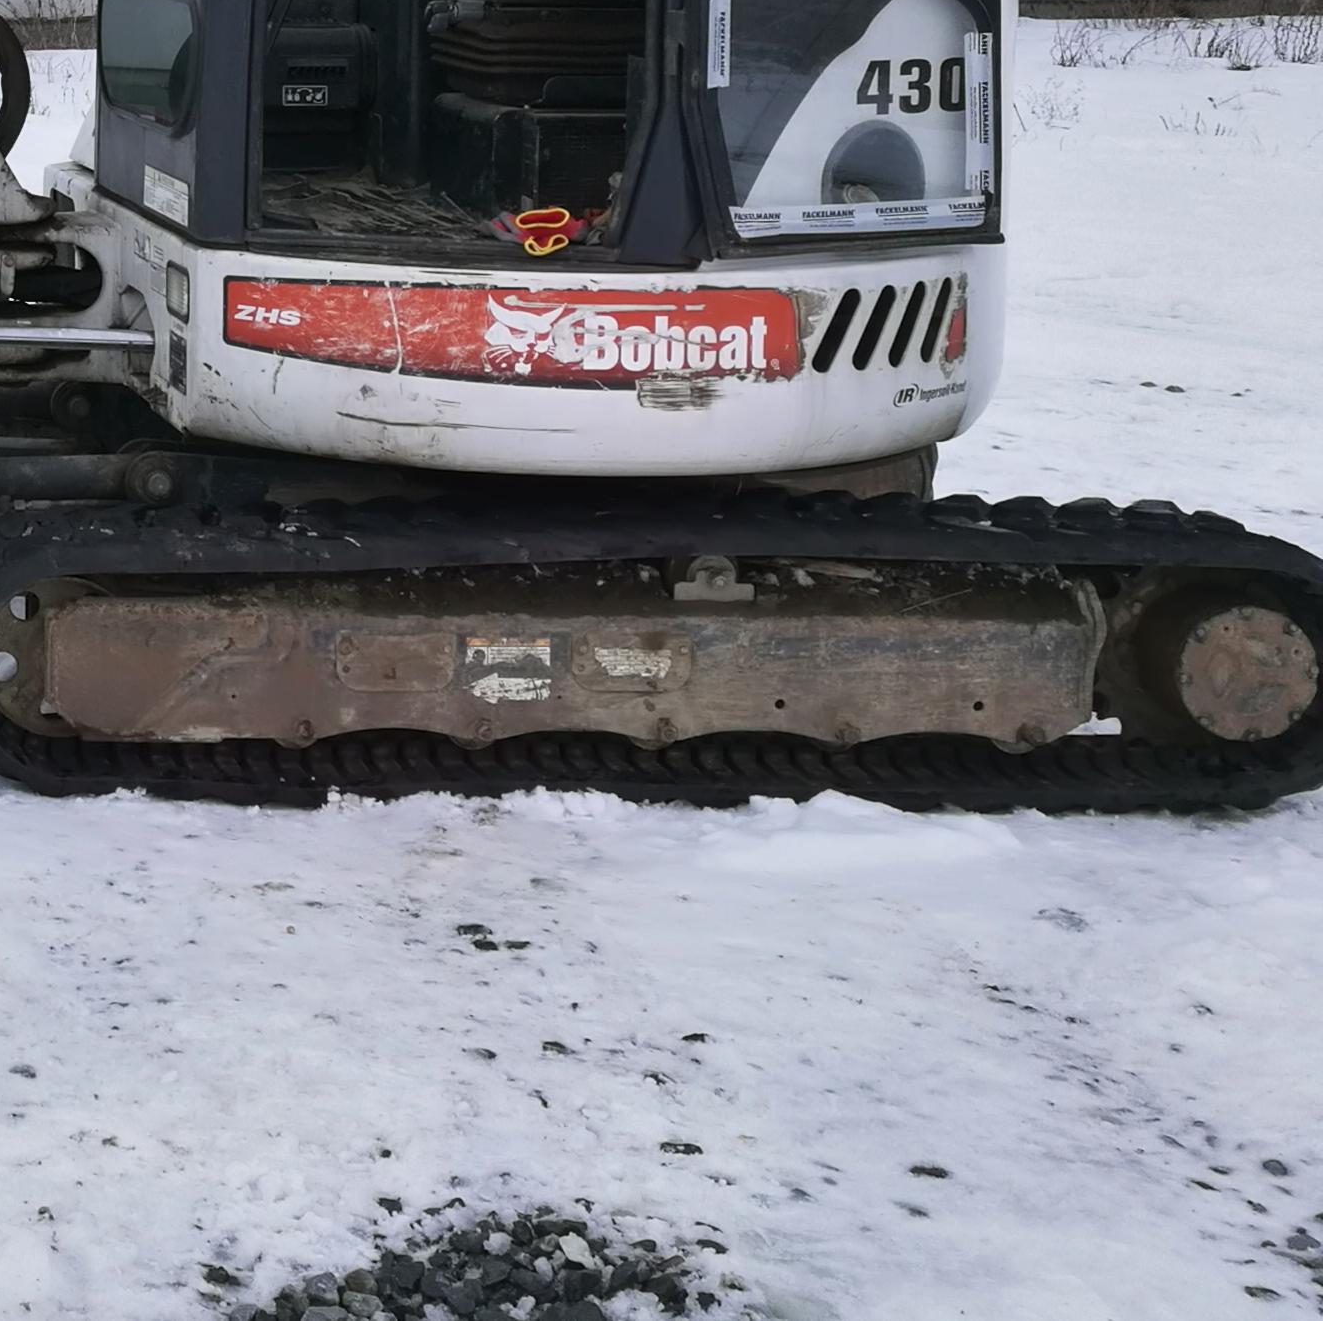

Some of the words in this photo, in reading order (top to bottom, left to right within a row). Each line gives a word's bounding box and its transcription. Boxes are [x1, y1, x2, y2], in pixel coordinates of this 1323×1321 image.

[856, 58, 966, 115] 430
[982, 81, 990, 144] FACKELMANN
[733, 212, 781, 220] FACKELMANN
[802, 209, 855, 219] FACKELMANN
[875, 205, 929, 215] FACKELMANN
[233, 303, 302, 327] ZHS
[582, 315, 768, 372] Bobcat
[895, 385, 917, 406] IR
